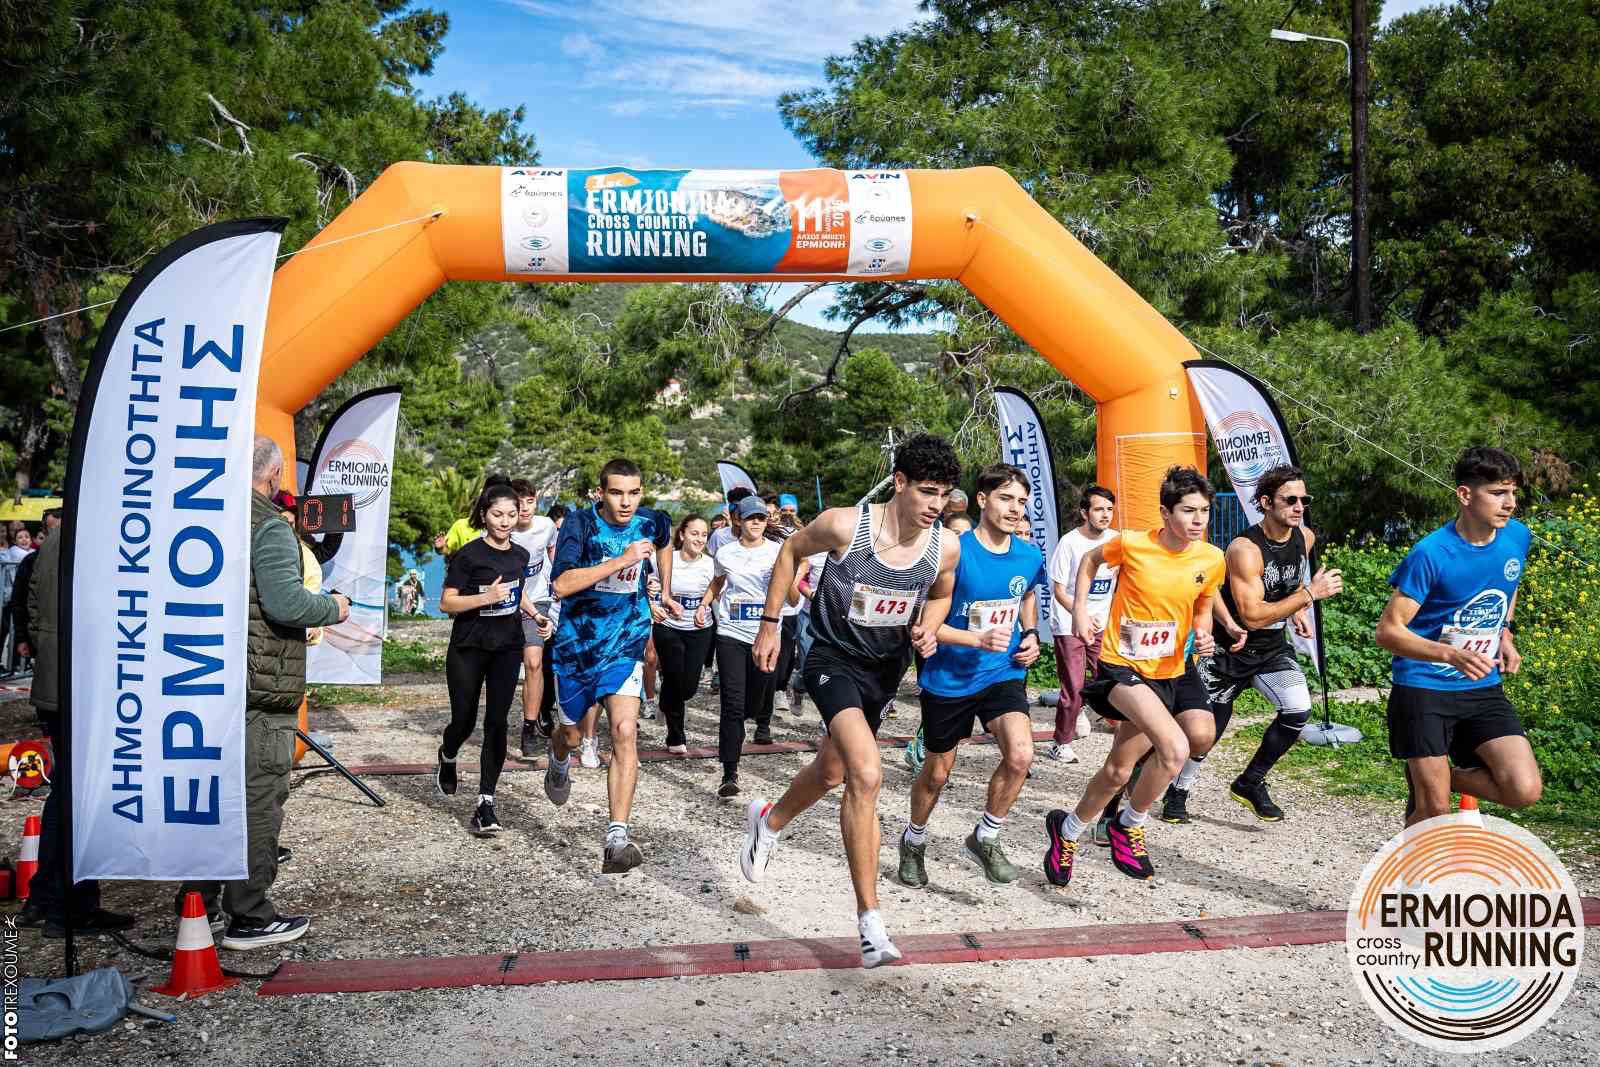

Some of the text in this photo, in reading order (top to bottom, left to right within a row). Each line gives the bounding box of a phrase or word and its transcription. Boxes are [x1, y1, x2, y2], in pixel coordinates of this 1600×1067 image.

[586, 189, 728, 214] ERMIONIDA
[587, 214, 697, 230] CROSS COUNTRY
[586, 230, 707, 256] RUNNING
[796, 240, 846, 249] ΕΡΜΙΟΝΗ
[328, 460, 389, 474] ERMIONIDA
[341, 474, 388, 487] RUNNING
[112, 317, 166, 824] ΔΗΜΟΤΙΚΗ ΚΟΙΝΟΤΗΤΑ
[161, 324, 245, 826] ΕΡΜΙΟΝΗΣ
[875, 600, 908, 615] 473
[990, 608, 1015, 625] 471
[1140, 631, 1170, 647] 469
